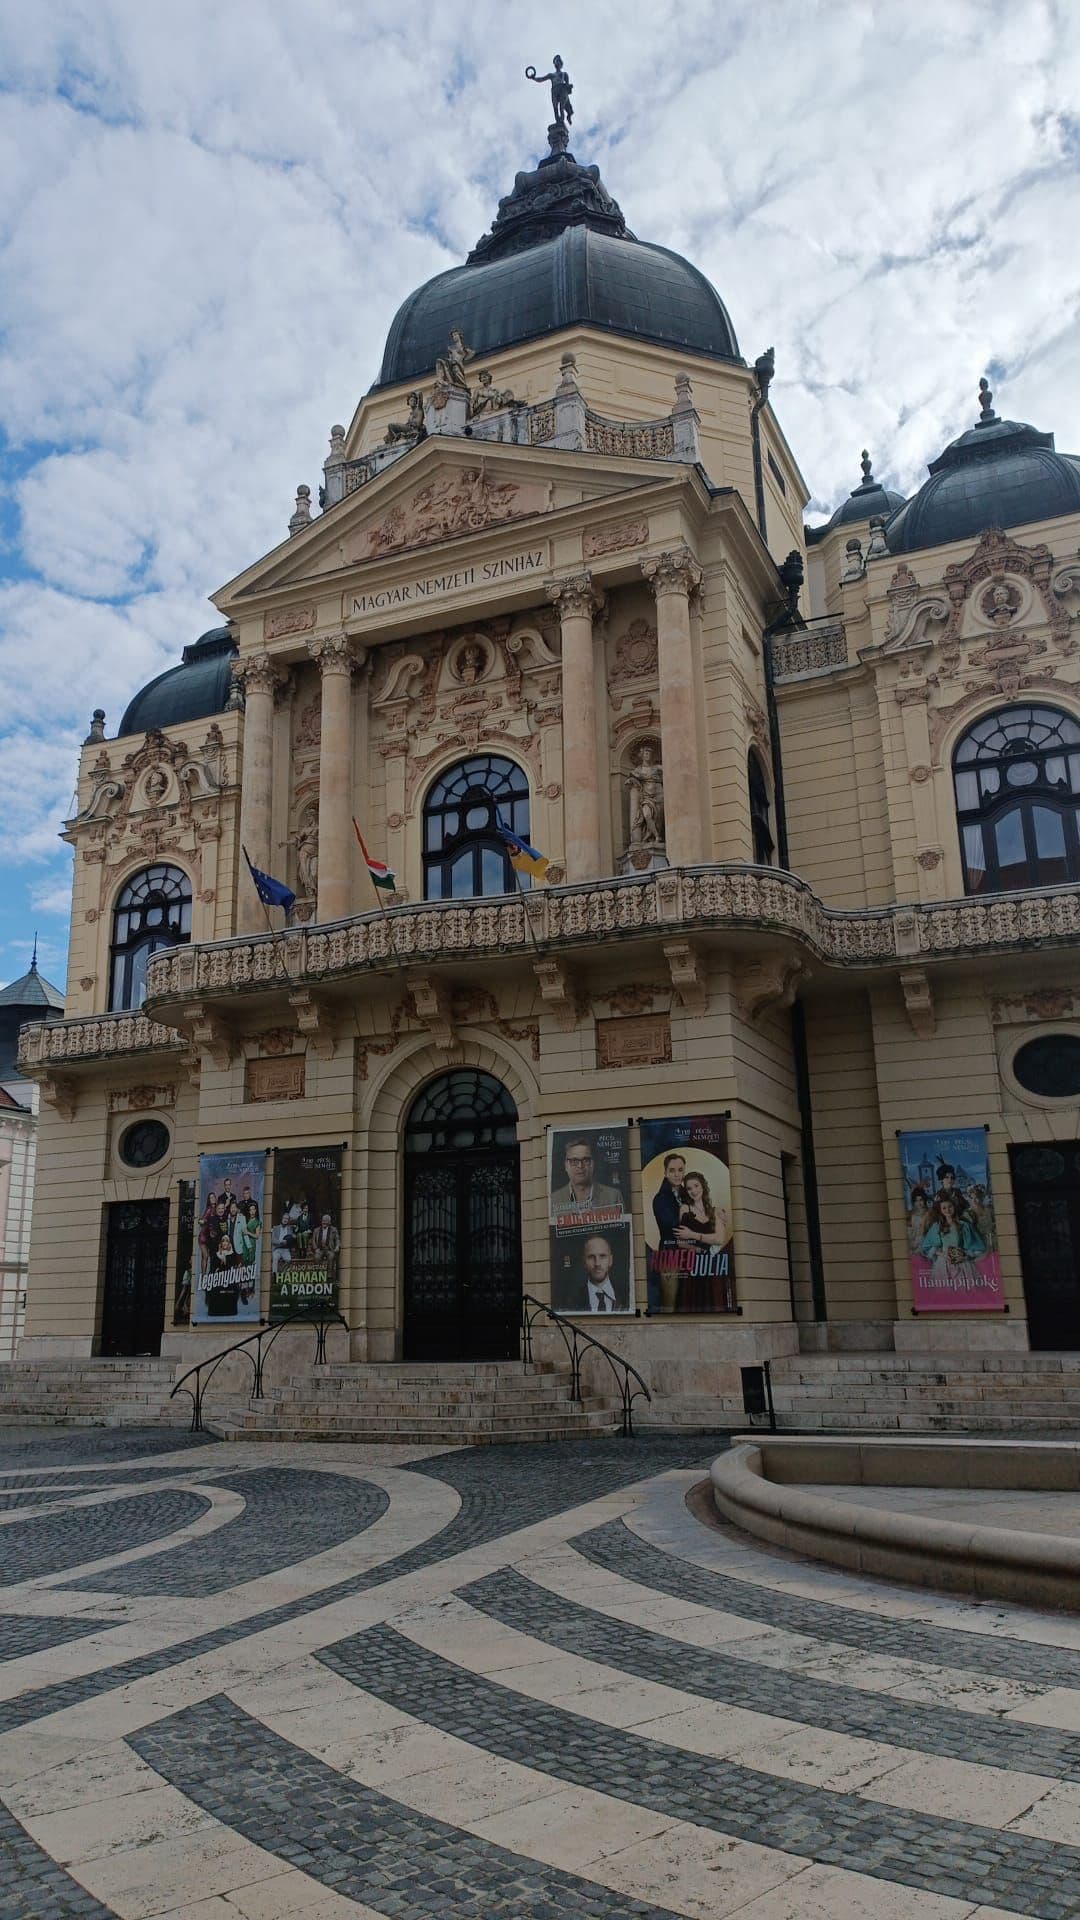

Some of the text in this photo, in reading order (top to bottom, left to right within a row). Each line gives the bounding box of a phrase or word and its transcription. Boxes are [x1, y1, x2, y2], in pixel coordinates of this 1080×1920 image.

[352, 586, 412, 614] MAGYAR
[415, 568, 475, 598] NEMZETI
[689, 1250, 730, 1277] JÚLIA
[280, 1283, 333, 1297] A PADON
